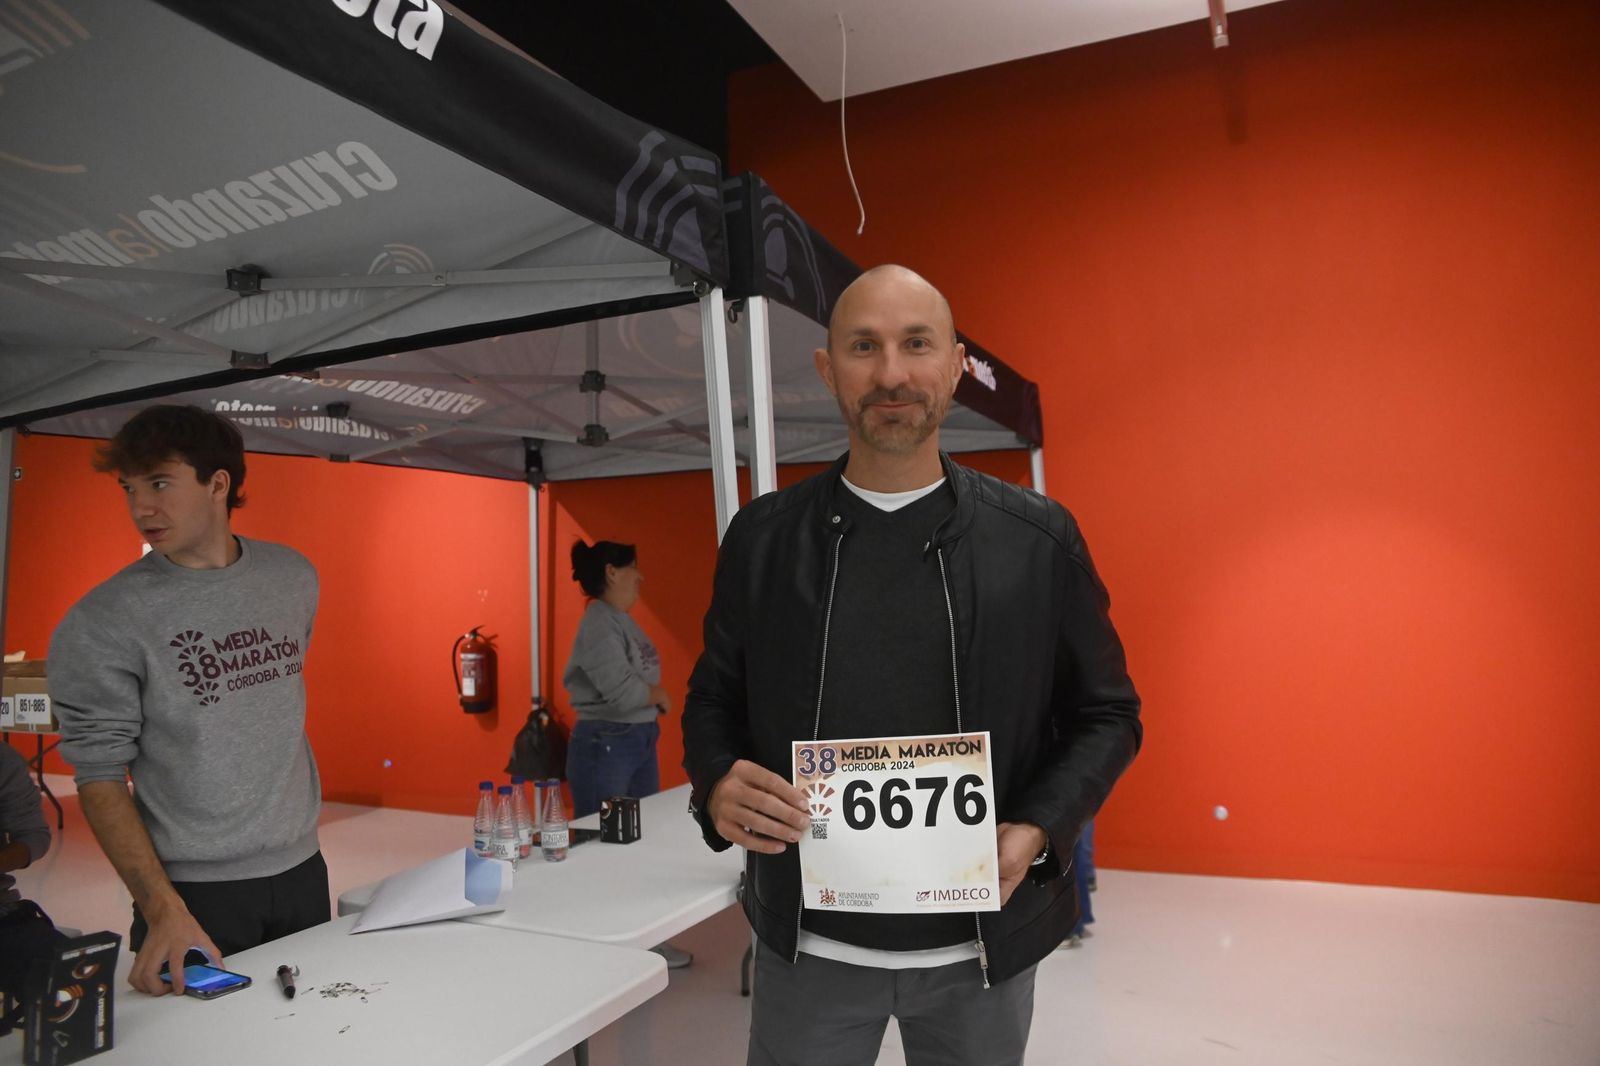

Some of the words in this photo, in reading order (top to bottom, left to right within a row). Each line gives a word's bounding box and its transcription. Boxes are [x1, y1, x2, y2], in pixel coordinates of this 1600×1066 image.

[212, 627, 273, 654] MEDIA
[220, 635, 299, 673] MARATÓN
[178, 653, 221, 687] 38
[227, 667, 281, 692] CÓRDOBA
[799, 747, 837, 775] 38
[841, 745, 891, 761] MEDIA
[898, 737, 982, 759] MARATÓN
[890, 760, 915, 770] 2024
[842, 774, 988, 830] 6676
[933, 887, 990, 902] IMDECO
